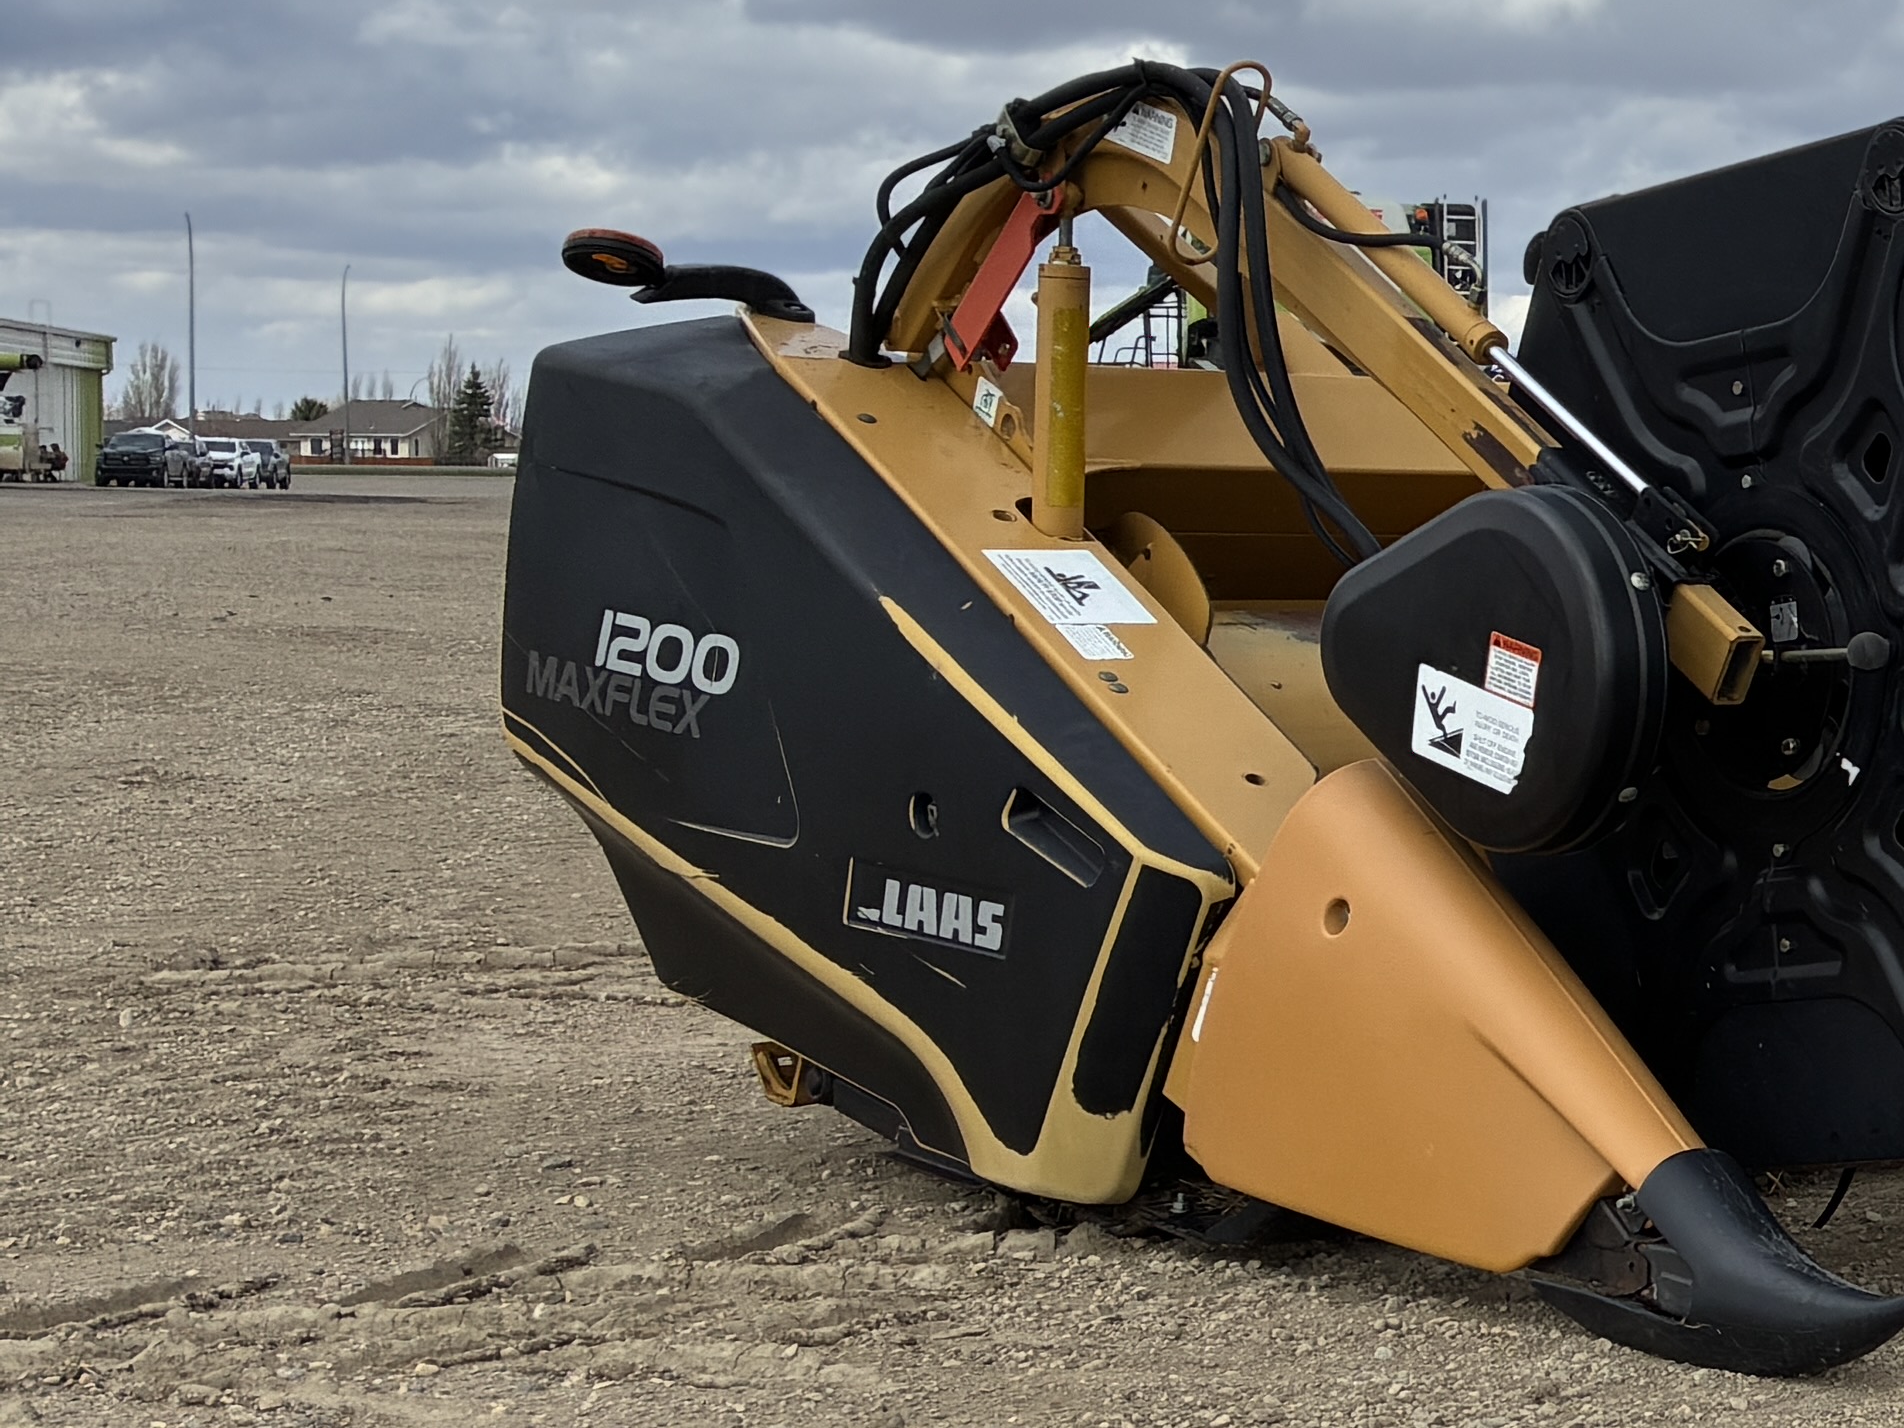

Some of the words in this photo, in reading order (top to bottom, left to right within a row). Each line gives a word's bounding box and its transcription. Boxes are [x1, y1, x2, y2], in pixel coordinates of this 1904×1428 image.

[526, 649, 711, 739] MAXFLEX
[595, 608, 740, 695] 1200
[857, 878, 1005, 951] LAAS
